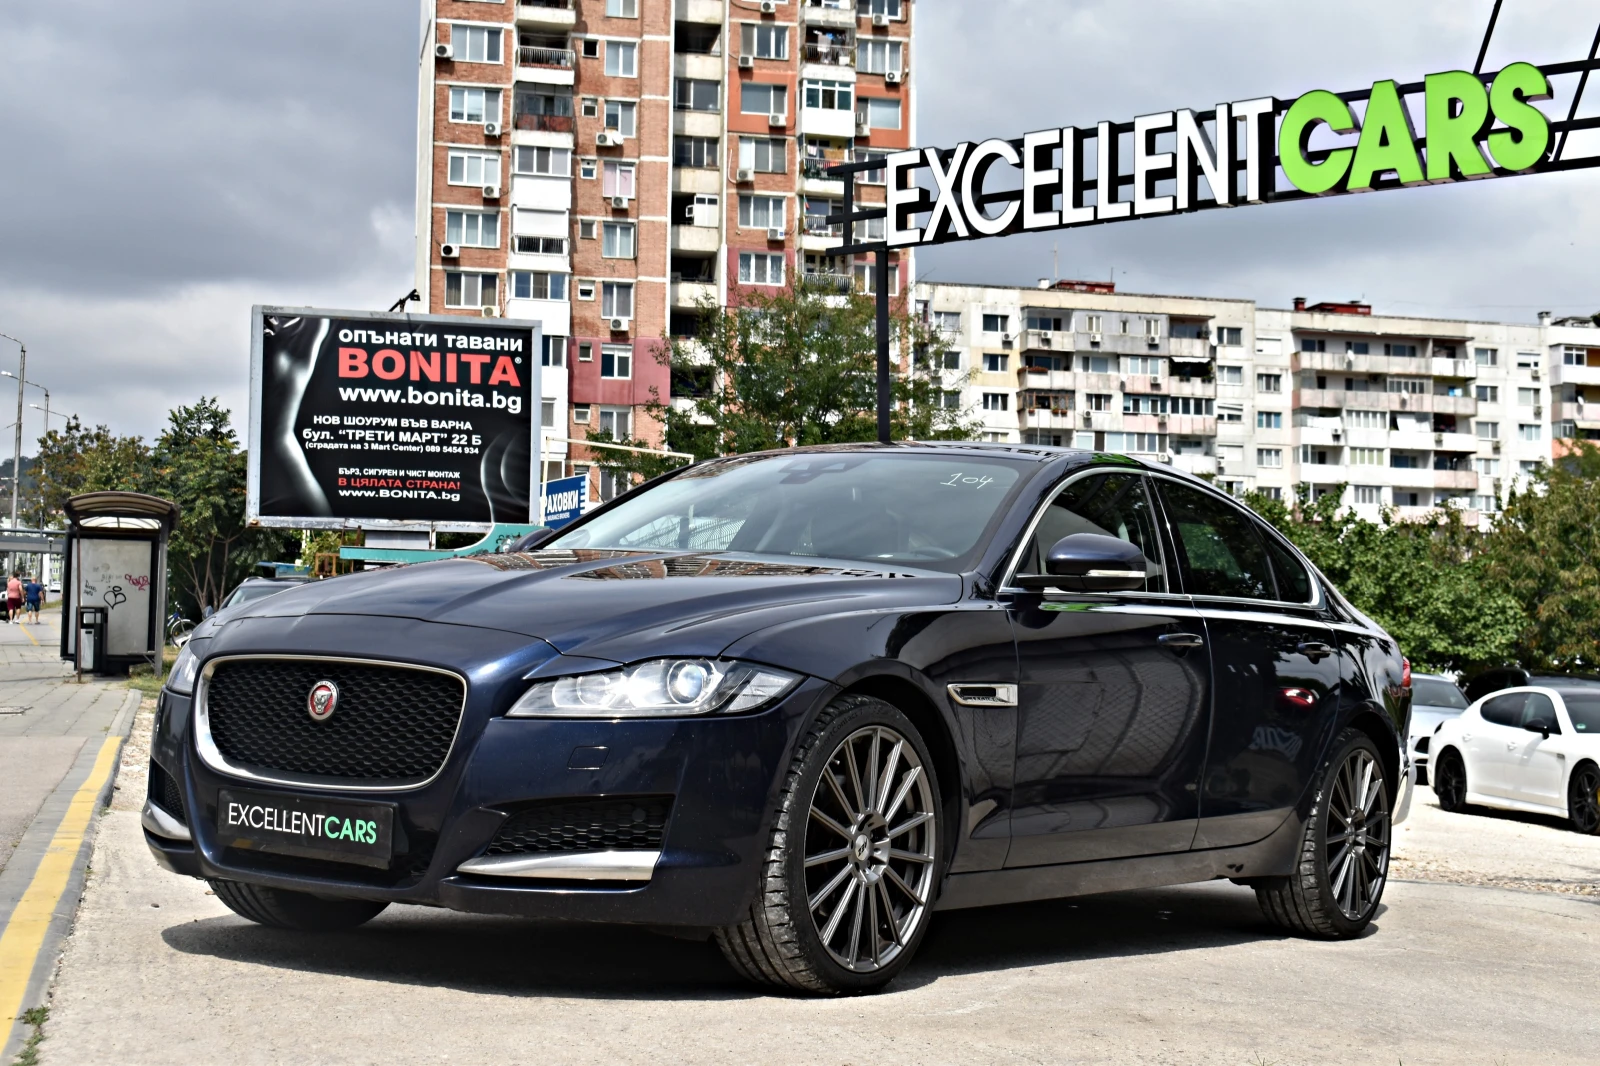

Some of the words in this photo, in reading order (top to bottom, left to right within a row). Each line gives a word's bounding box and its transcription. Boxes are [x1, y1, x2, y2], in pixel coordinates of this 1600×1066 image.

[338, 329, 437, 347] опънати
[444, 334, 523, 352] тавани
[338, 386, 522, 414] www.bonita.bg
[313, 415, 340, 425] НОВ
[343, 416, 397, 427] ШОУРУМ
[400, 418, 428, 429] ВЪВ
[431, 419, 473, 431] ВАРНА
[302, 428, 334, 442] бул.
[451, 434, 468, 445] 22
[471, 434, 482, 446] Б
[305, 441, 348, 451] (сградата
[363, 442, 369, 450] 3
[370, 442, 390, 451] Mart
[392, 443, 423, 453] Center)
[425, 445, 441, 453] 089
[442, 446, 462, 454] 5454
[464, 447, 479, 455] 934
[363, 468, 398, 477] СИГУРЕН
[399, 469, 405, 477] И
[406, 470, 426, 478] ЧИСТ
[427, 470, 460, 479] МОНТАЖ
[940, 472, 994, 490] 104
[338, 477, 347, 486] В
[351, 478, 402, 488] ЦЯЛАТА
[406, 480, 460, 490] СТРАНА!
[338, 489, 460, 502] www.BONITA.bg
